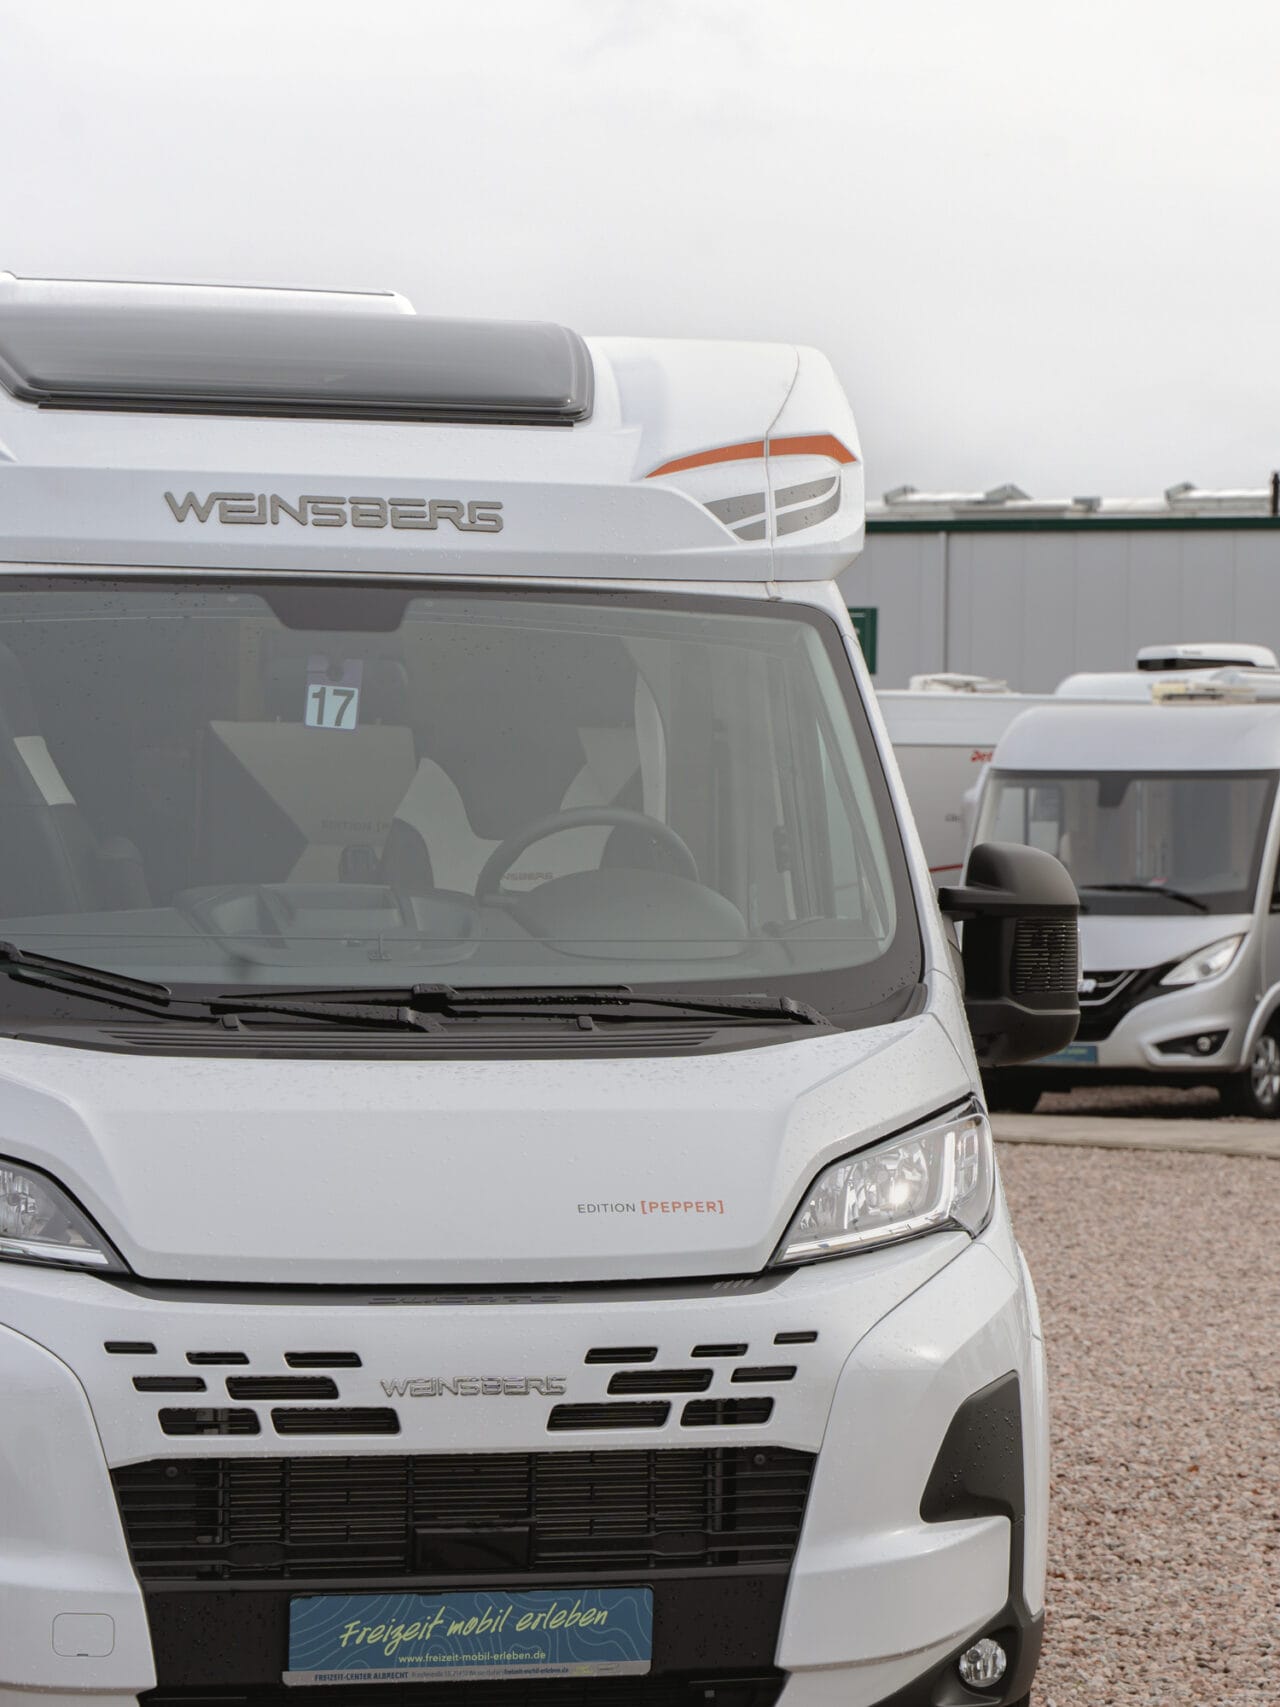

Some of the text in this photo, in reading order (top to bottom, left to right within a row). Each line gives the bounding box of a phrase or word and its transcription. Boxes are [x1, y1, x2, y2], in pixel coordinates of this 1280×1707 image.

[164, 491, 503, 533] WEINSBERG
[312, 686, 355, 727] 17
[577, 1200, 725, 1215] EDITION [PEPPER]
[380, 1375, 567, 1398] WEINSBERG
[339, 1600, 609, 1657] Freizeit mobil erleben
[398, 1650, 547, 1664] www.freizeit-mobil-erleben.de
